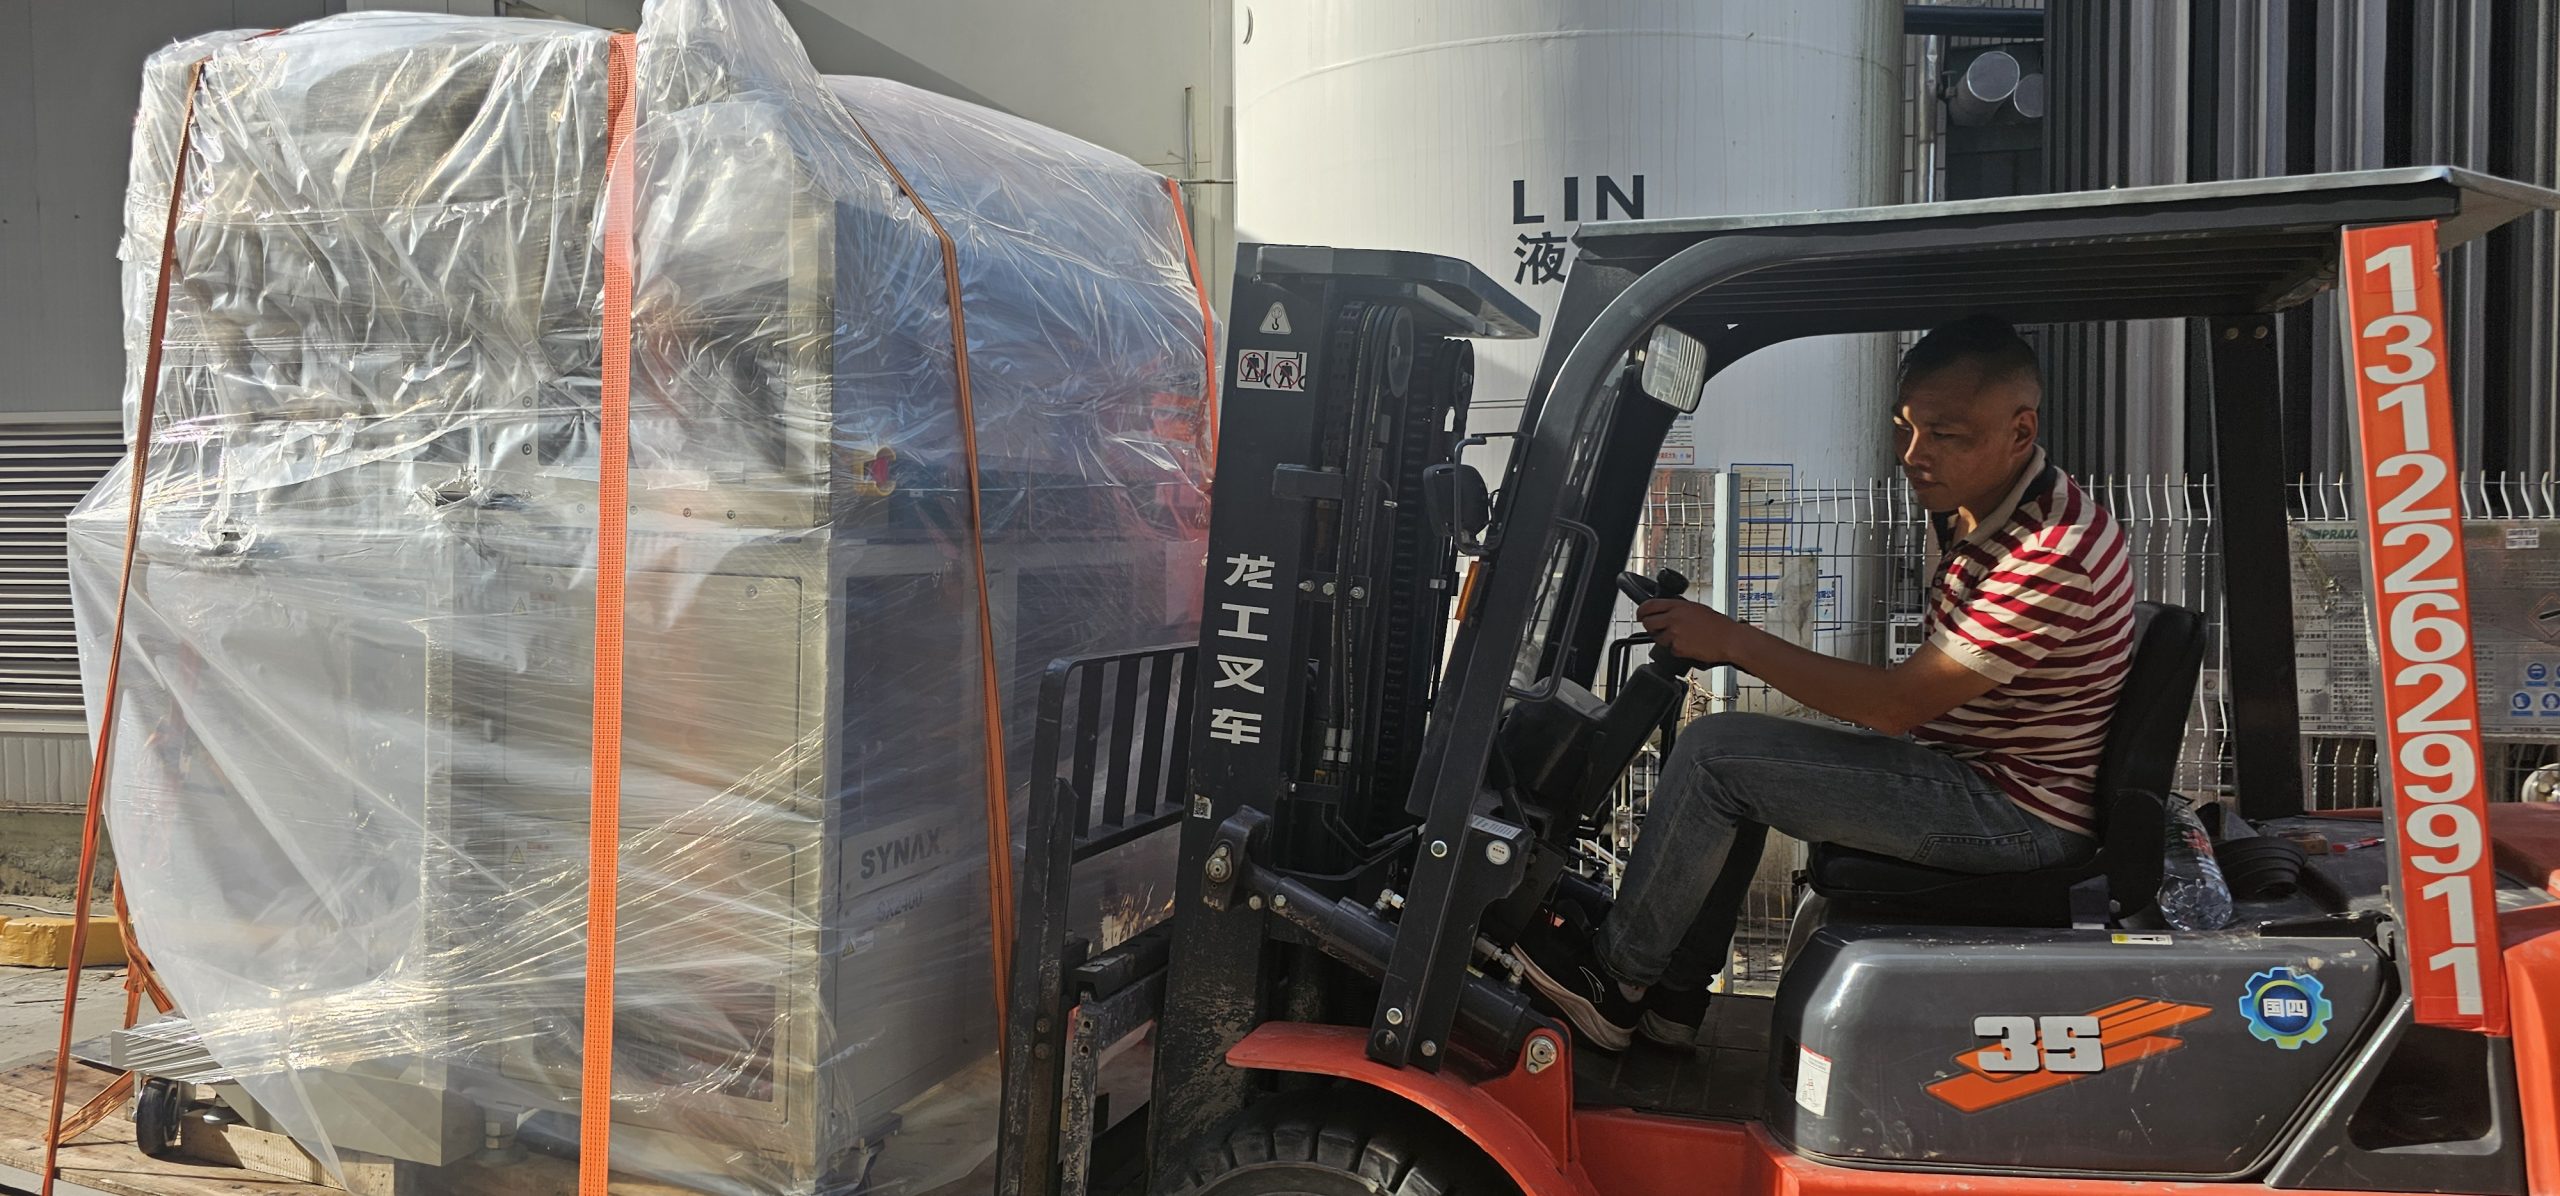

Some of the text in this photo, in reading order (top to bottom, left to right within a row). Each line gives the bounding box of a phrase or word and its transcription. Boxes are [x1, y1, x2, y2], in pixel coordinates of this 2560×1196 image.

[1513, 175, 1645, 225] LIN
[1513, 231, 1567, 286] 液
[1210, 553, 1276, 745] 龙工叉车
[2362, 244, 2485, 1016] 13122629911
[860, 826, 942, 880] SYNAX
[2263, 998, 2308, 1018] 国四
[1974, 1016, 2104, 1072] 35
